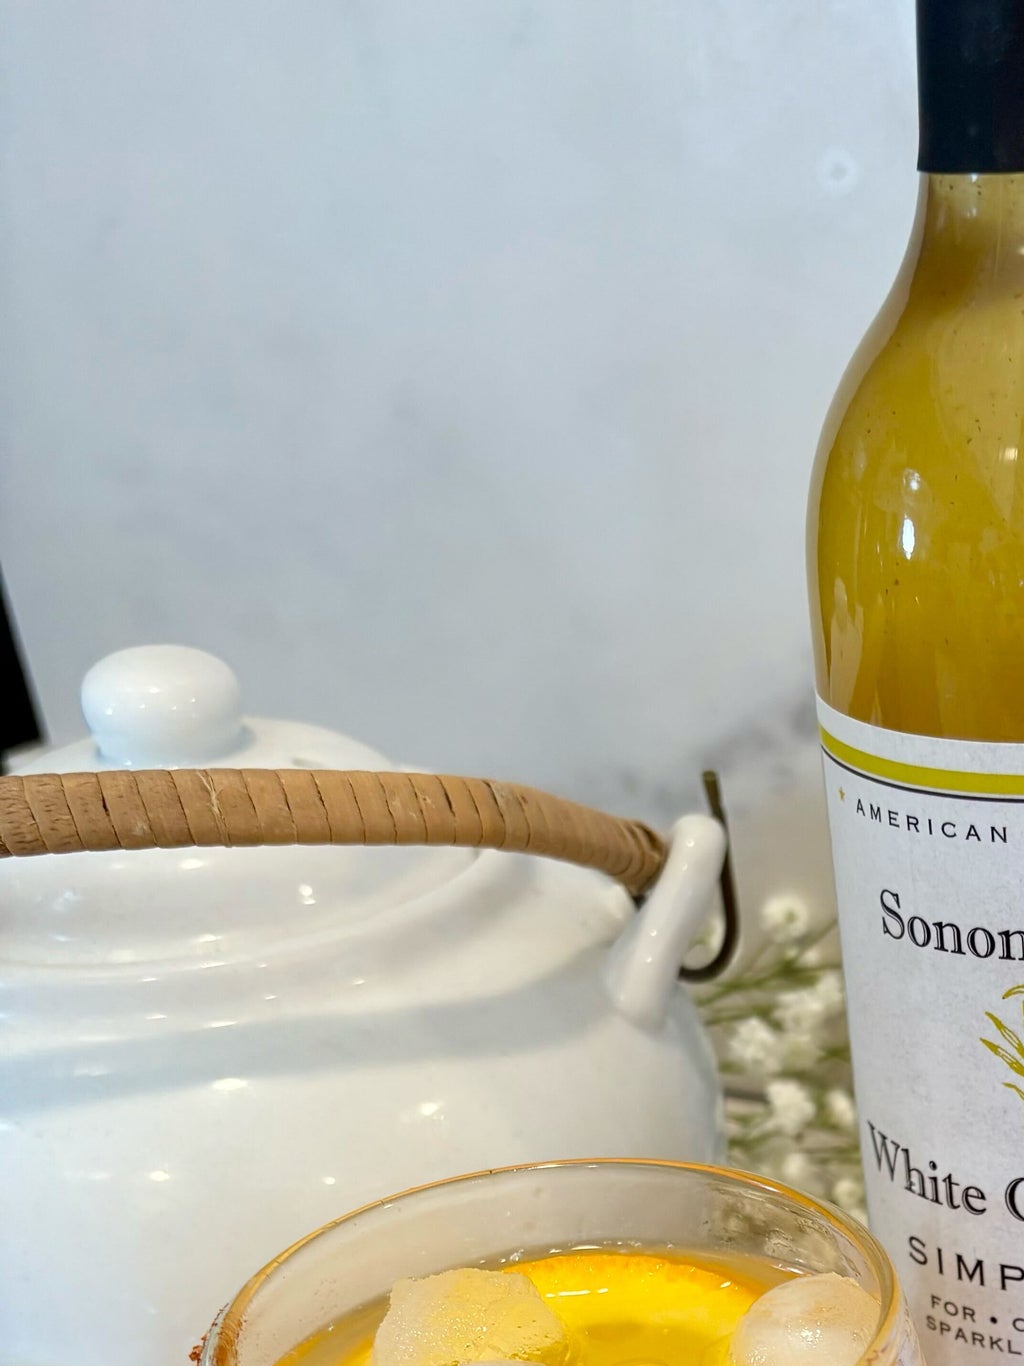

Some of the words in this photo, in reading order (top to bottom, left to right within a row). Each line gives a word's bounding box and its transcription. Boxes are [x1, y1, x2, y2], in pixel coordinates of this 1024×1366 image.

[857, 798, 1007, 843] AMERICAN
[866, 1120, 987, 1216] White
[931, 1294, 976, 1323] FOR
